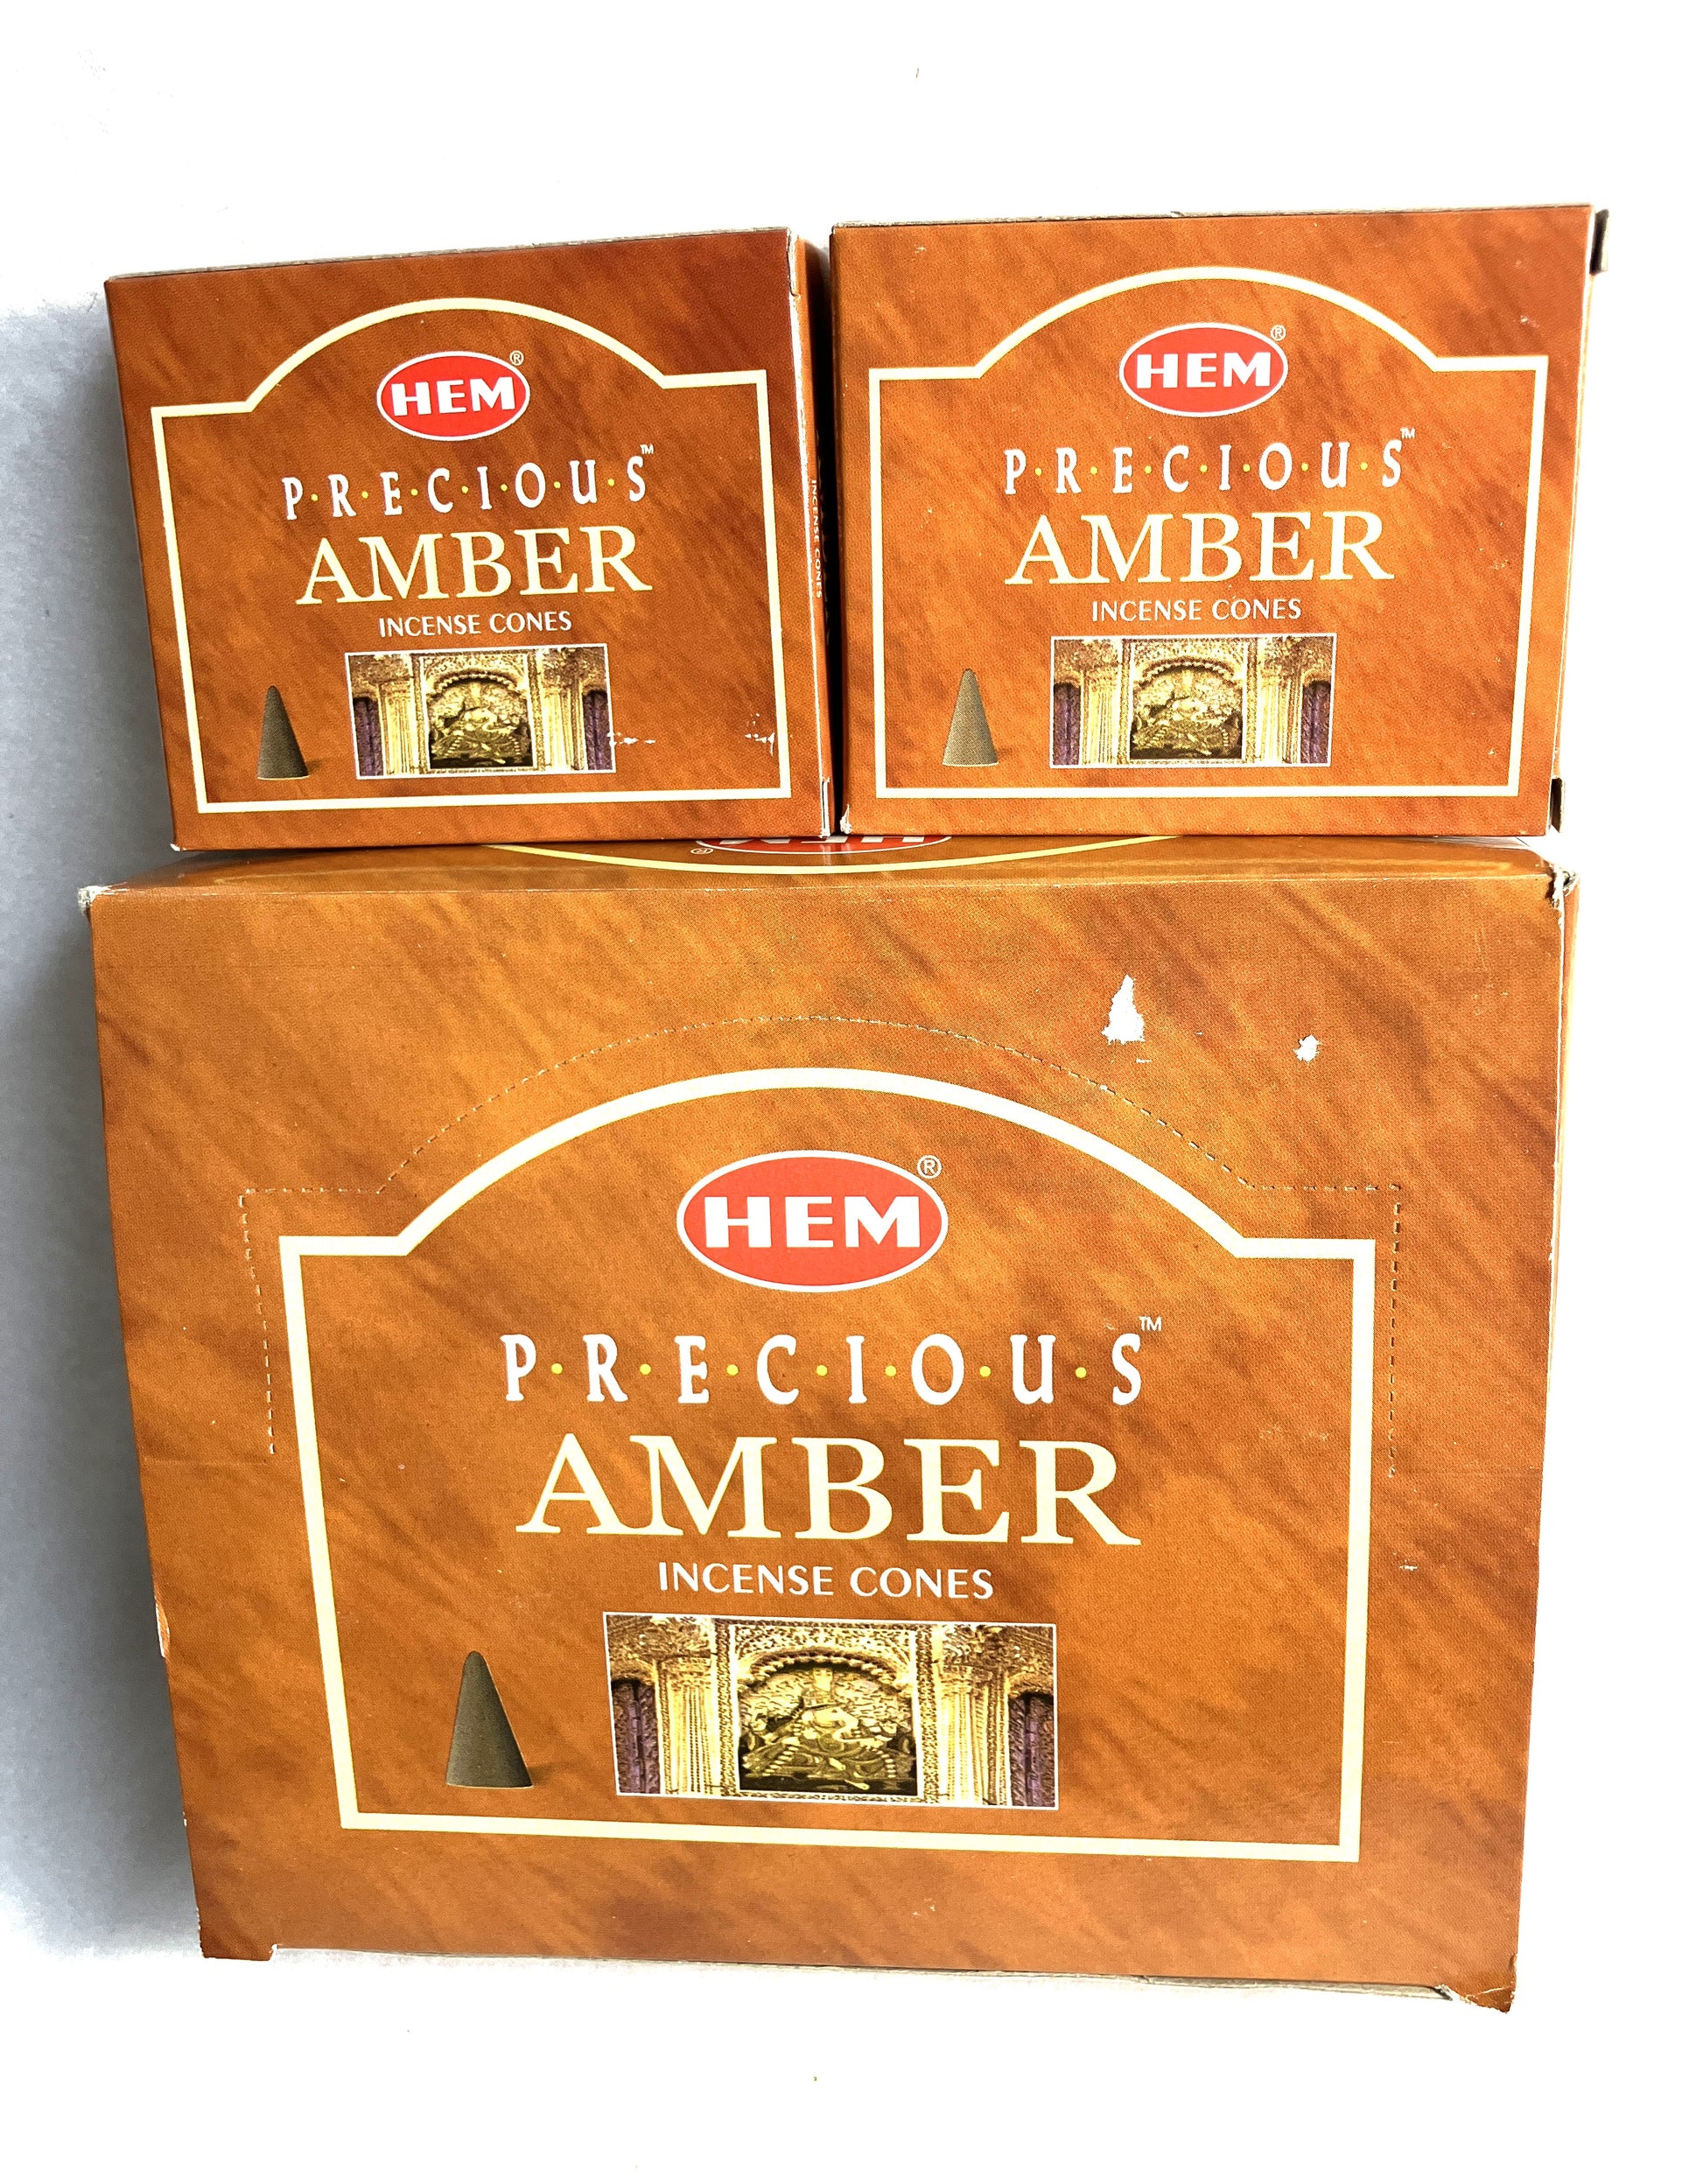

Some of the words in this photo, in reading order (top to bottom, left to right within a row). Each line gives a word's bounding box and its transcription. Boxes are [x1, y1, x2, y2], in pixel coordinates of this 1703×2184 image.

[390, 376, 515, 416] HEM
[1136, 352, 1272, 389] HEM
[810, 479, 821, 543] INCENSE
[295, 525, 653, 605] AMBER
[814, 547, 823, 599] CONES
[1004, 510, 1395, 585] AMBER
[379, 613, 481, 638] INCENSE
[488, 610, 572, 634] CONES
[1091, 598, 1203, 622] INCENSE
[1211, 598, 1301, 620] CONES
[704, 1196, 921, 1249] HEM
[515, 1432, 1142, 1546] AMBER
[658, 1562, 834, 1596] INCENSE
[850, 1566, 994, 1600] CONES
